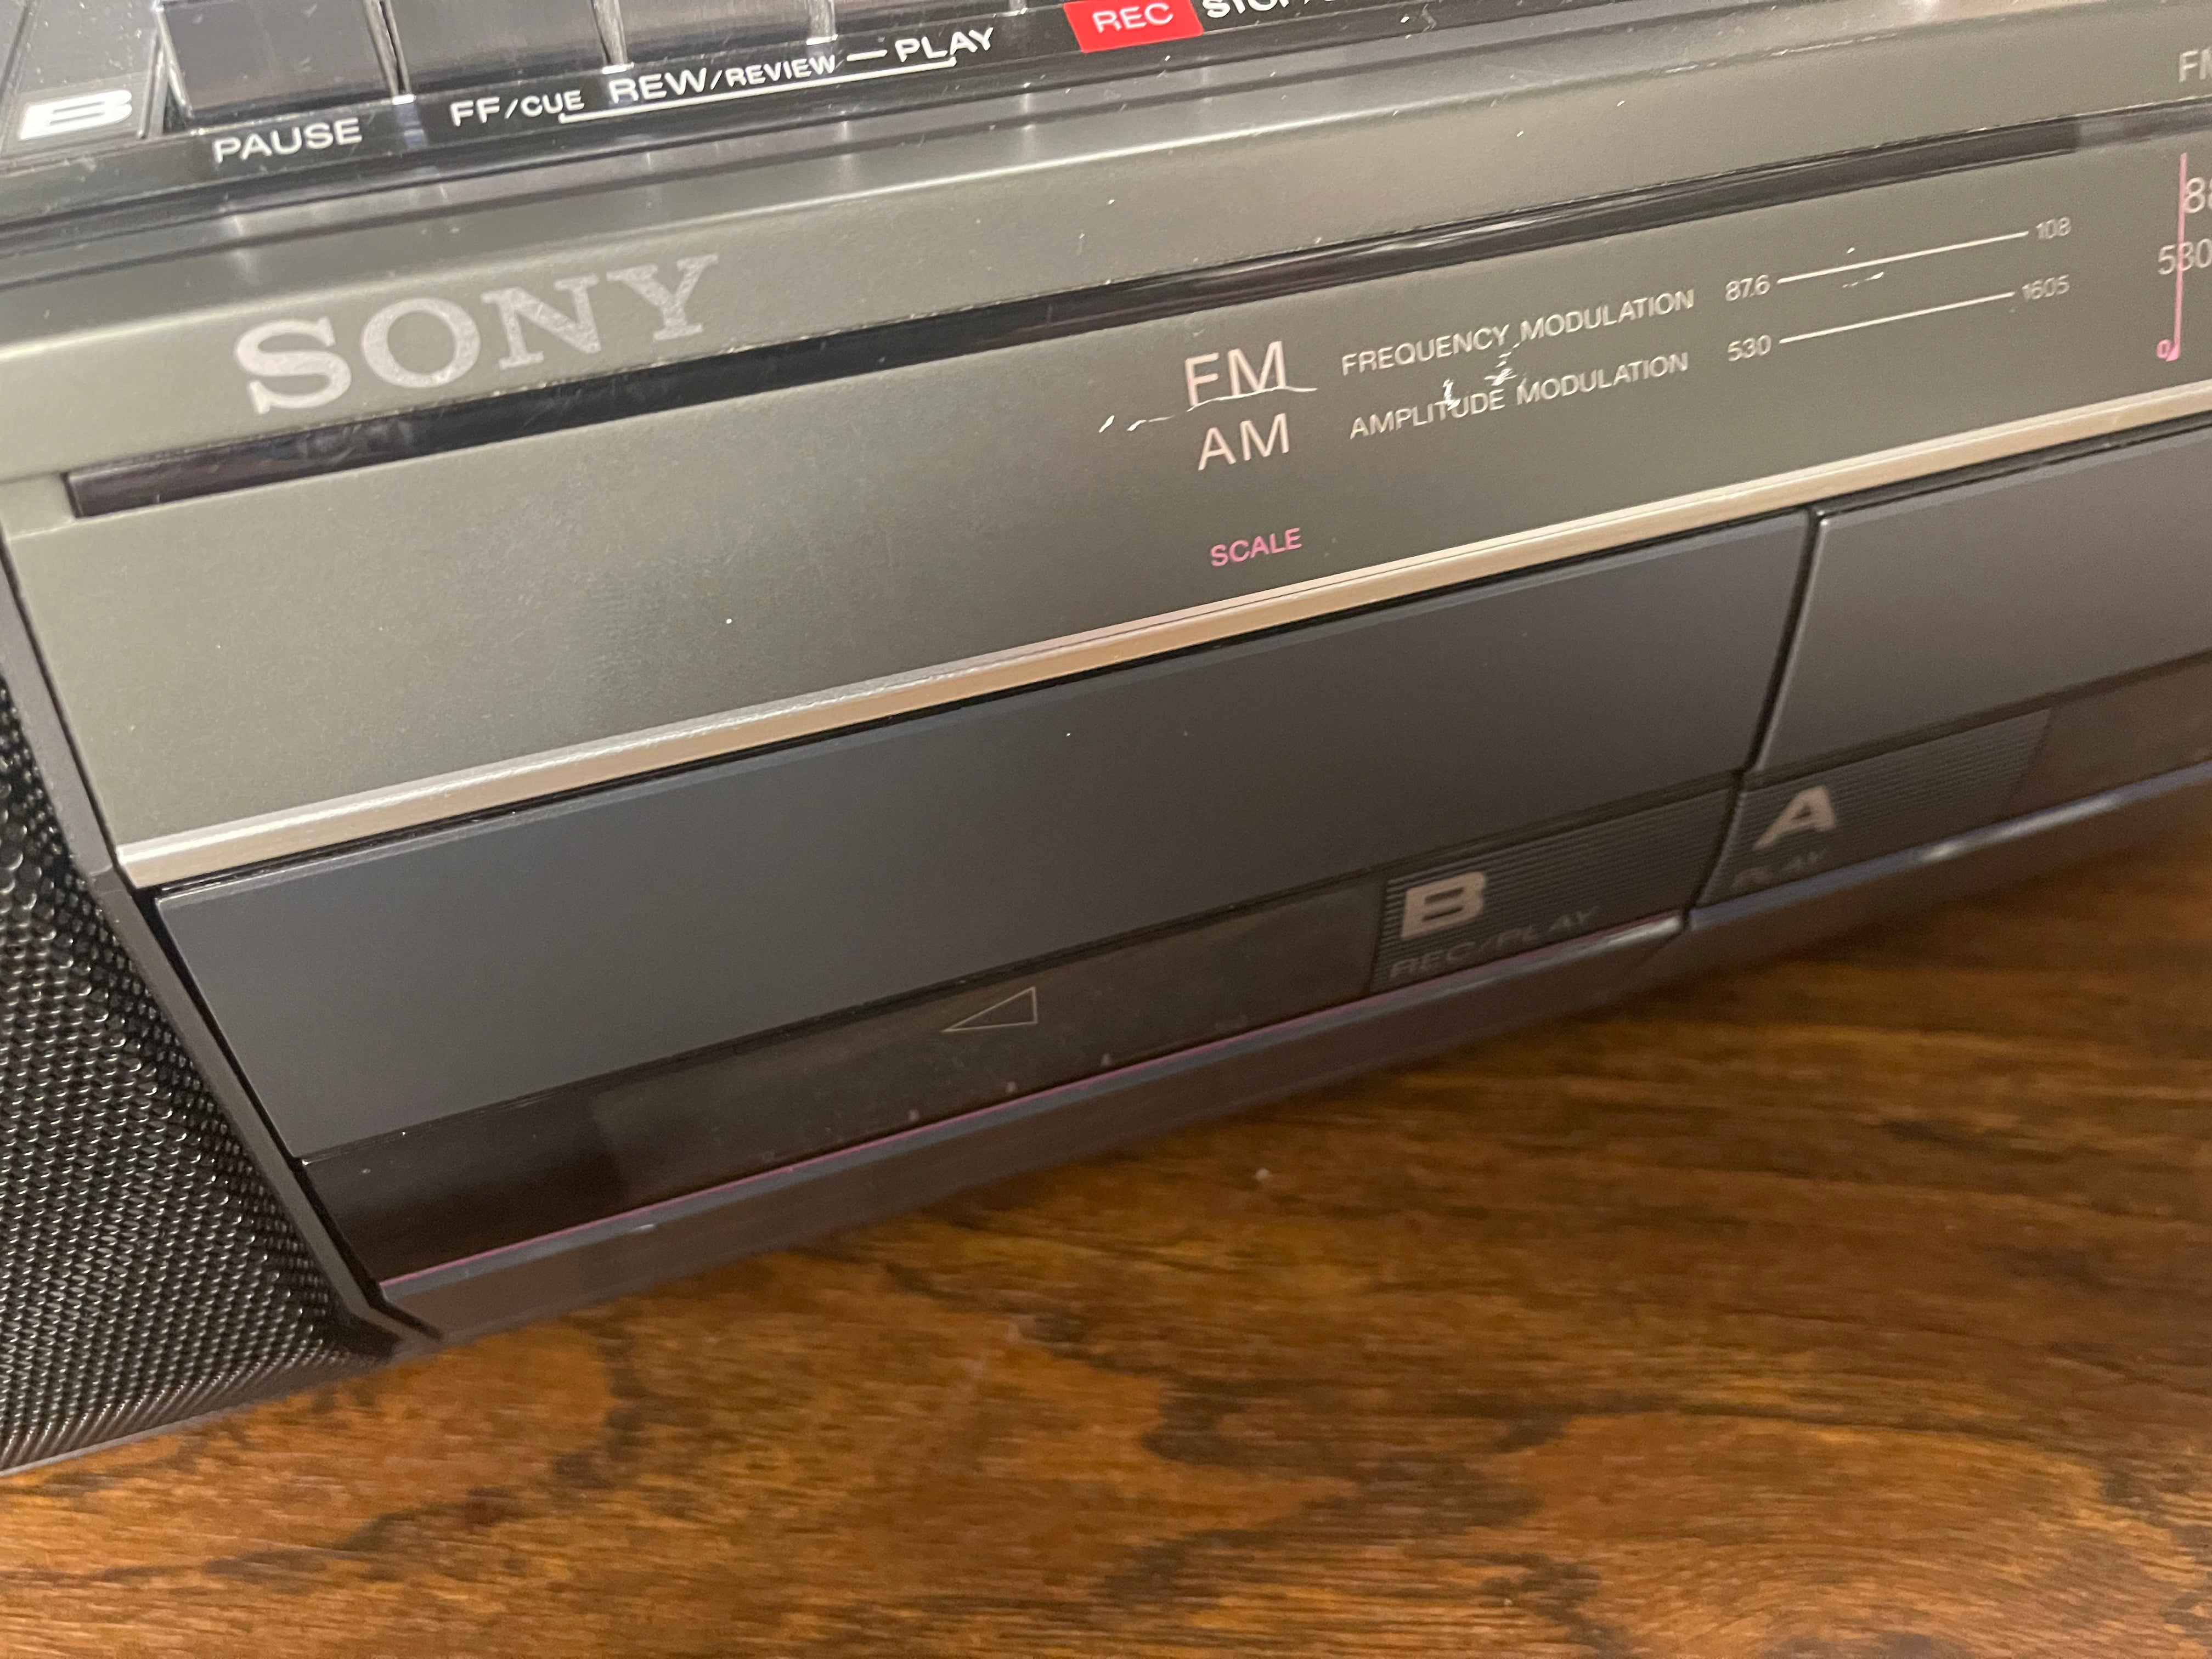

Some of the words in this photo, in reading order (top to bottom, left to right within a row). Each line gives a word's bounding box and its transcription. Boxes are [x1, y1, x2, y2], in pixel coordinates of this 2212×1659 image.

[1092, 2, 1173, 33] REC
[449, 89, 585, 127] FF/CUE
[608, 54, 836, 104] REW/REVIEW
[894, 27, 994, 63] PLAY
[18, 91, 132, 140] B
[212, 117, 362, 163] PAUSE
[234, 253, 719, 414] SONY
[1185, 341, 1286, 407] FM
[1342, 324, 1510, 376] FREQUENCY
[1520, 289, 1695, 341] MODULATION
[2036, 216, 2072, 240] 108
[1198, 413, 1290, 471] AM
[1350, 388, 1505, 439] AMPLITUDE
[1516, 352, 1689, 405] MODULATION
[1727, 335, 1771, 362] 530
[2022, 274, 2071, 300] 1605
[1210, 527, 1302, 567] SCALE
[1754, 785, 1837, 850] A
[1401, 872, 1486, 940] B
